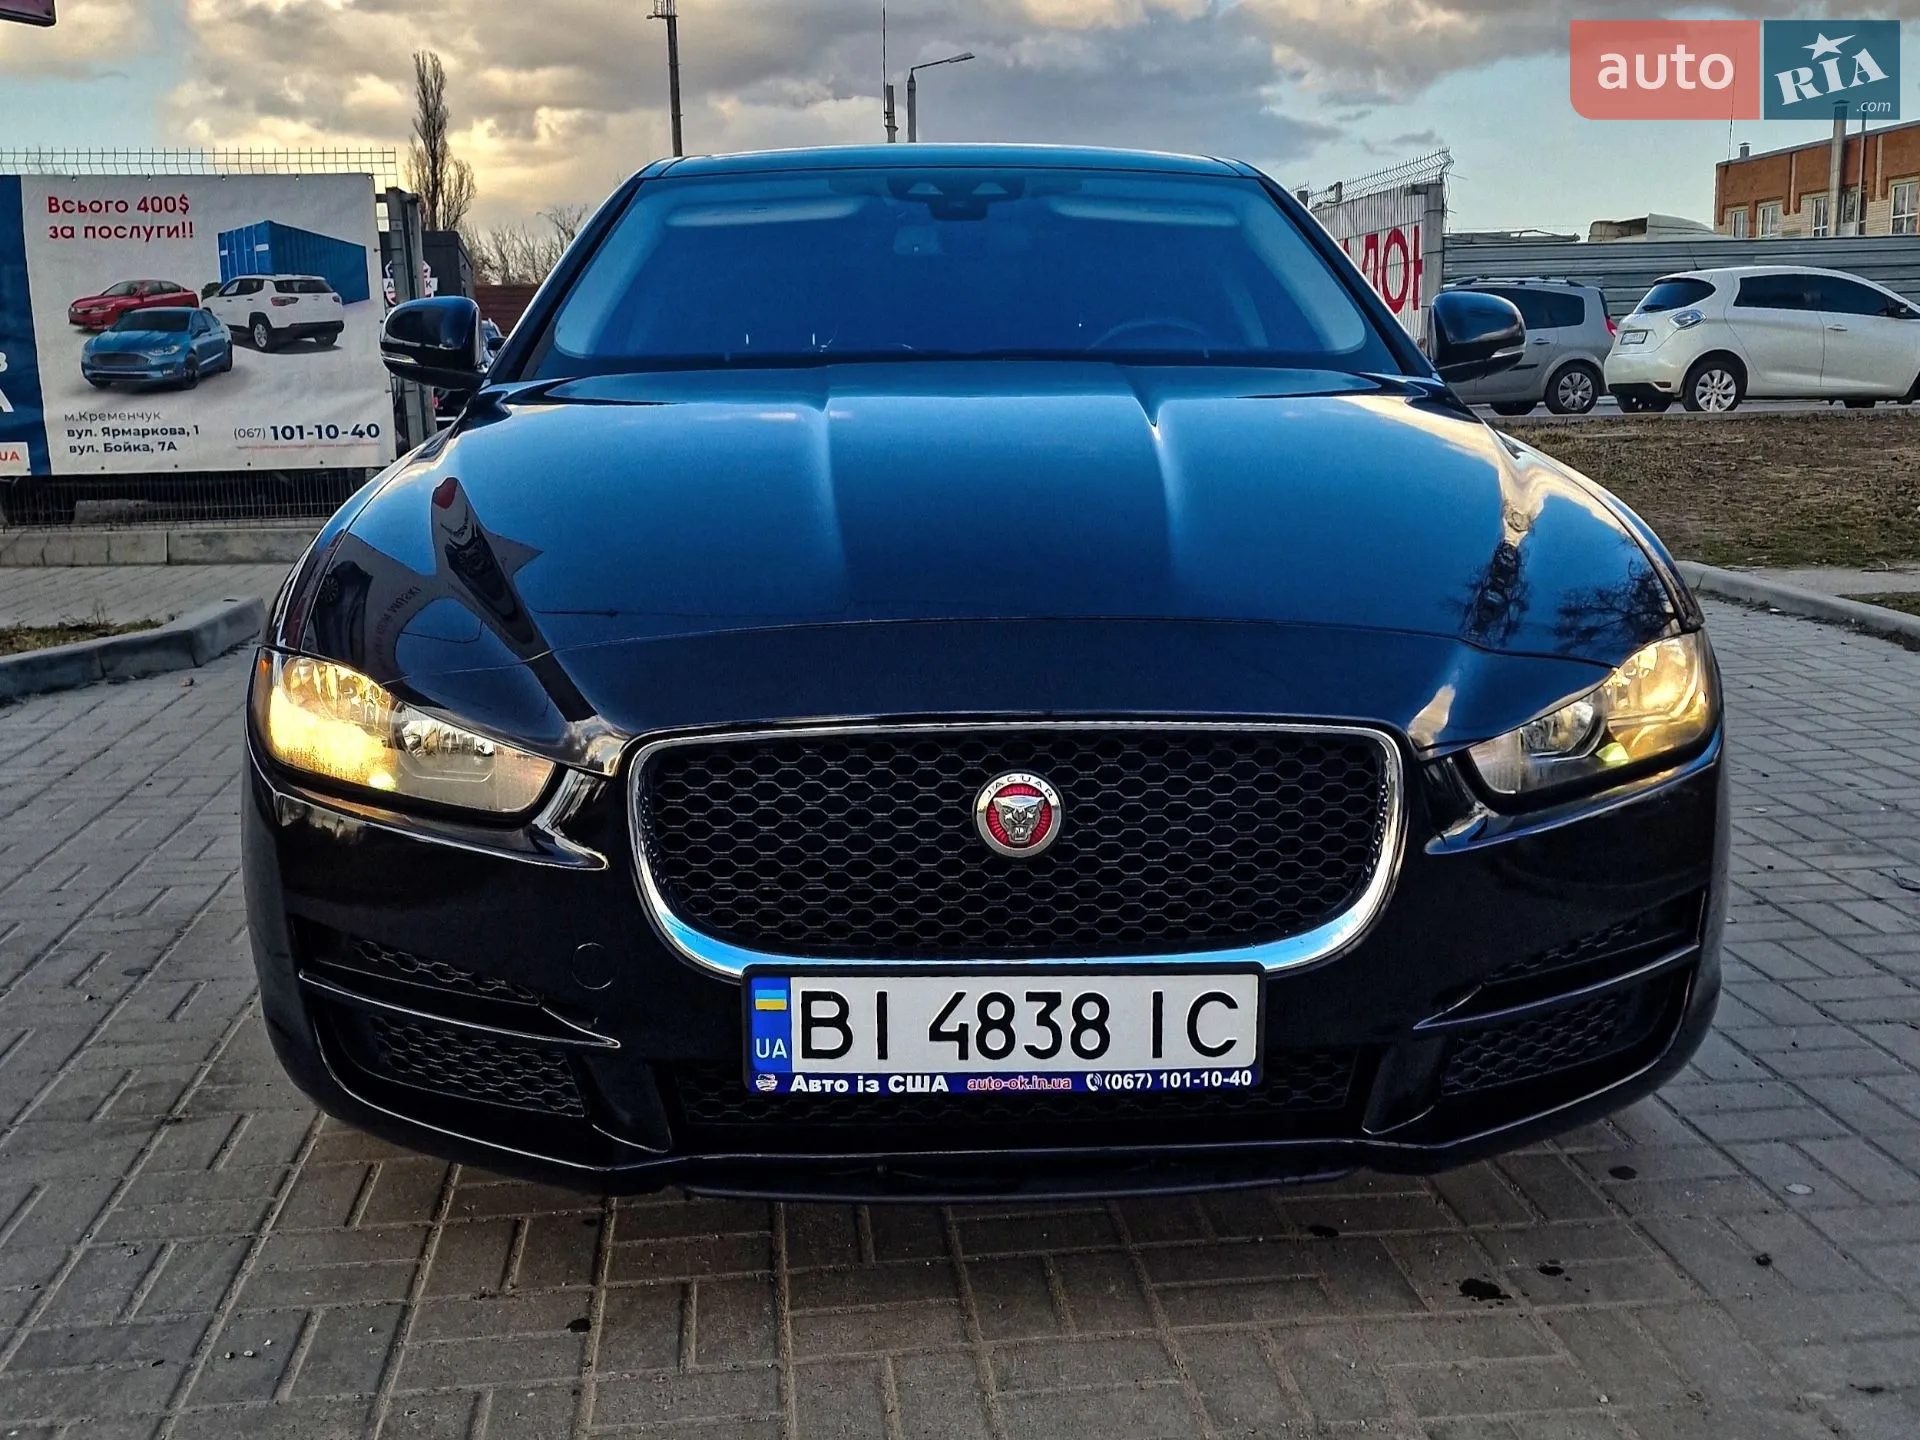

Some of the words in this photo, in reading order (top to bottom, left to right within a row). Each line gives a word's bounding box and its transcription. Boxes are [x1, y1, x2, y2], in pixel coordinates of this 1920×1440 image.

[47, 196, 129, 213] Всього
[136, 193, 189, 215] 400$
[49, 225, 75, 239] за
[84, 221, 194, 242] послуги!!
[64, 411, 161, 423] м.Кременчук
[67, 427, 97, 439] вул.
[101, 426, 190, 439] Ярмаркова,
[193, 425, 199, 435] 1
[233, 428, 266, 440] (067)
[270, 423, 380, 440] 101-10-40
[69, 443, 99, 455] вул.
[103, 441, 154, 453] Бойка,
[158, 441, 177, 451] 7А
[987, 775, 1053, 798] JAGUAR
[801, 990, 888, 1060] BI
[928, 991, 1111, 1060] 4838
[1151, 990, 1239, 1058] IC
[755, 1038, 787, 1059] UA
[790, 1075, 849, 1092] Авто
[857, 1075, 880, 1093] із
[888, 1075, 949, 1093] США
[967, 1076, 1072, 1091] auto-ok.in.ua
[1104, 1073, 1152, 1090] (067)
[1159, 1070, 1252, 1088] 101-10-40
